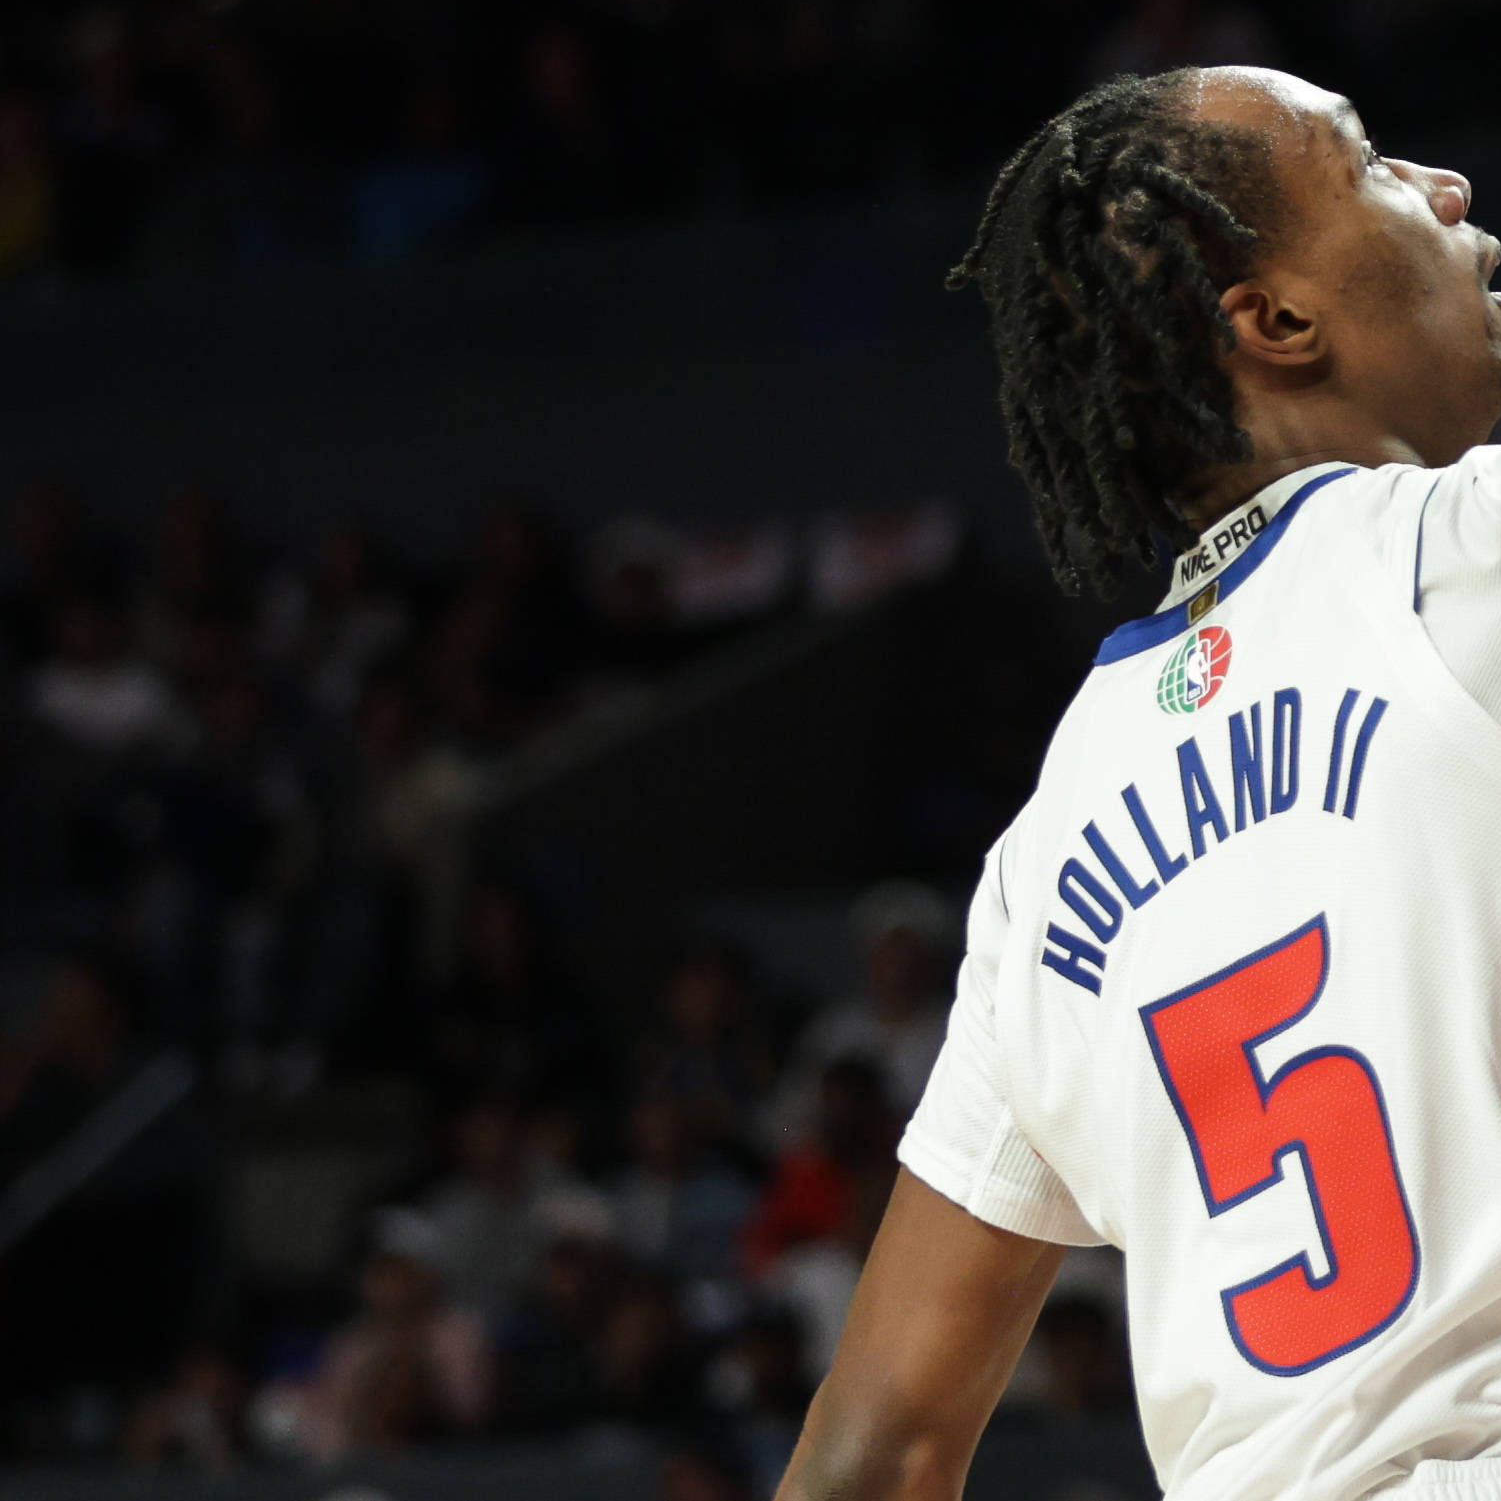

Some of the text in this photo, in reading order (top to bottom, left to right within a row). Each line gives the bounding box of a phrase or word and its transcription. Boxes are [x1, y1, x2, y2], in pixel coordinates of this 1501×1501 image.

[1180, 505, 1268, 587] NIKE PRO
[1040, 686, 1390, 998] HOLLAND II
[1138, 911, 1422, 1378] 5
